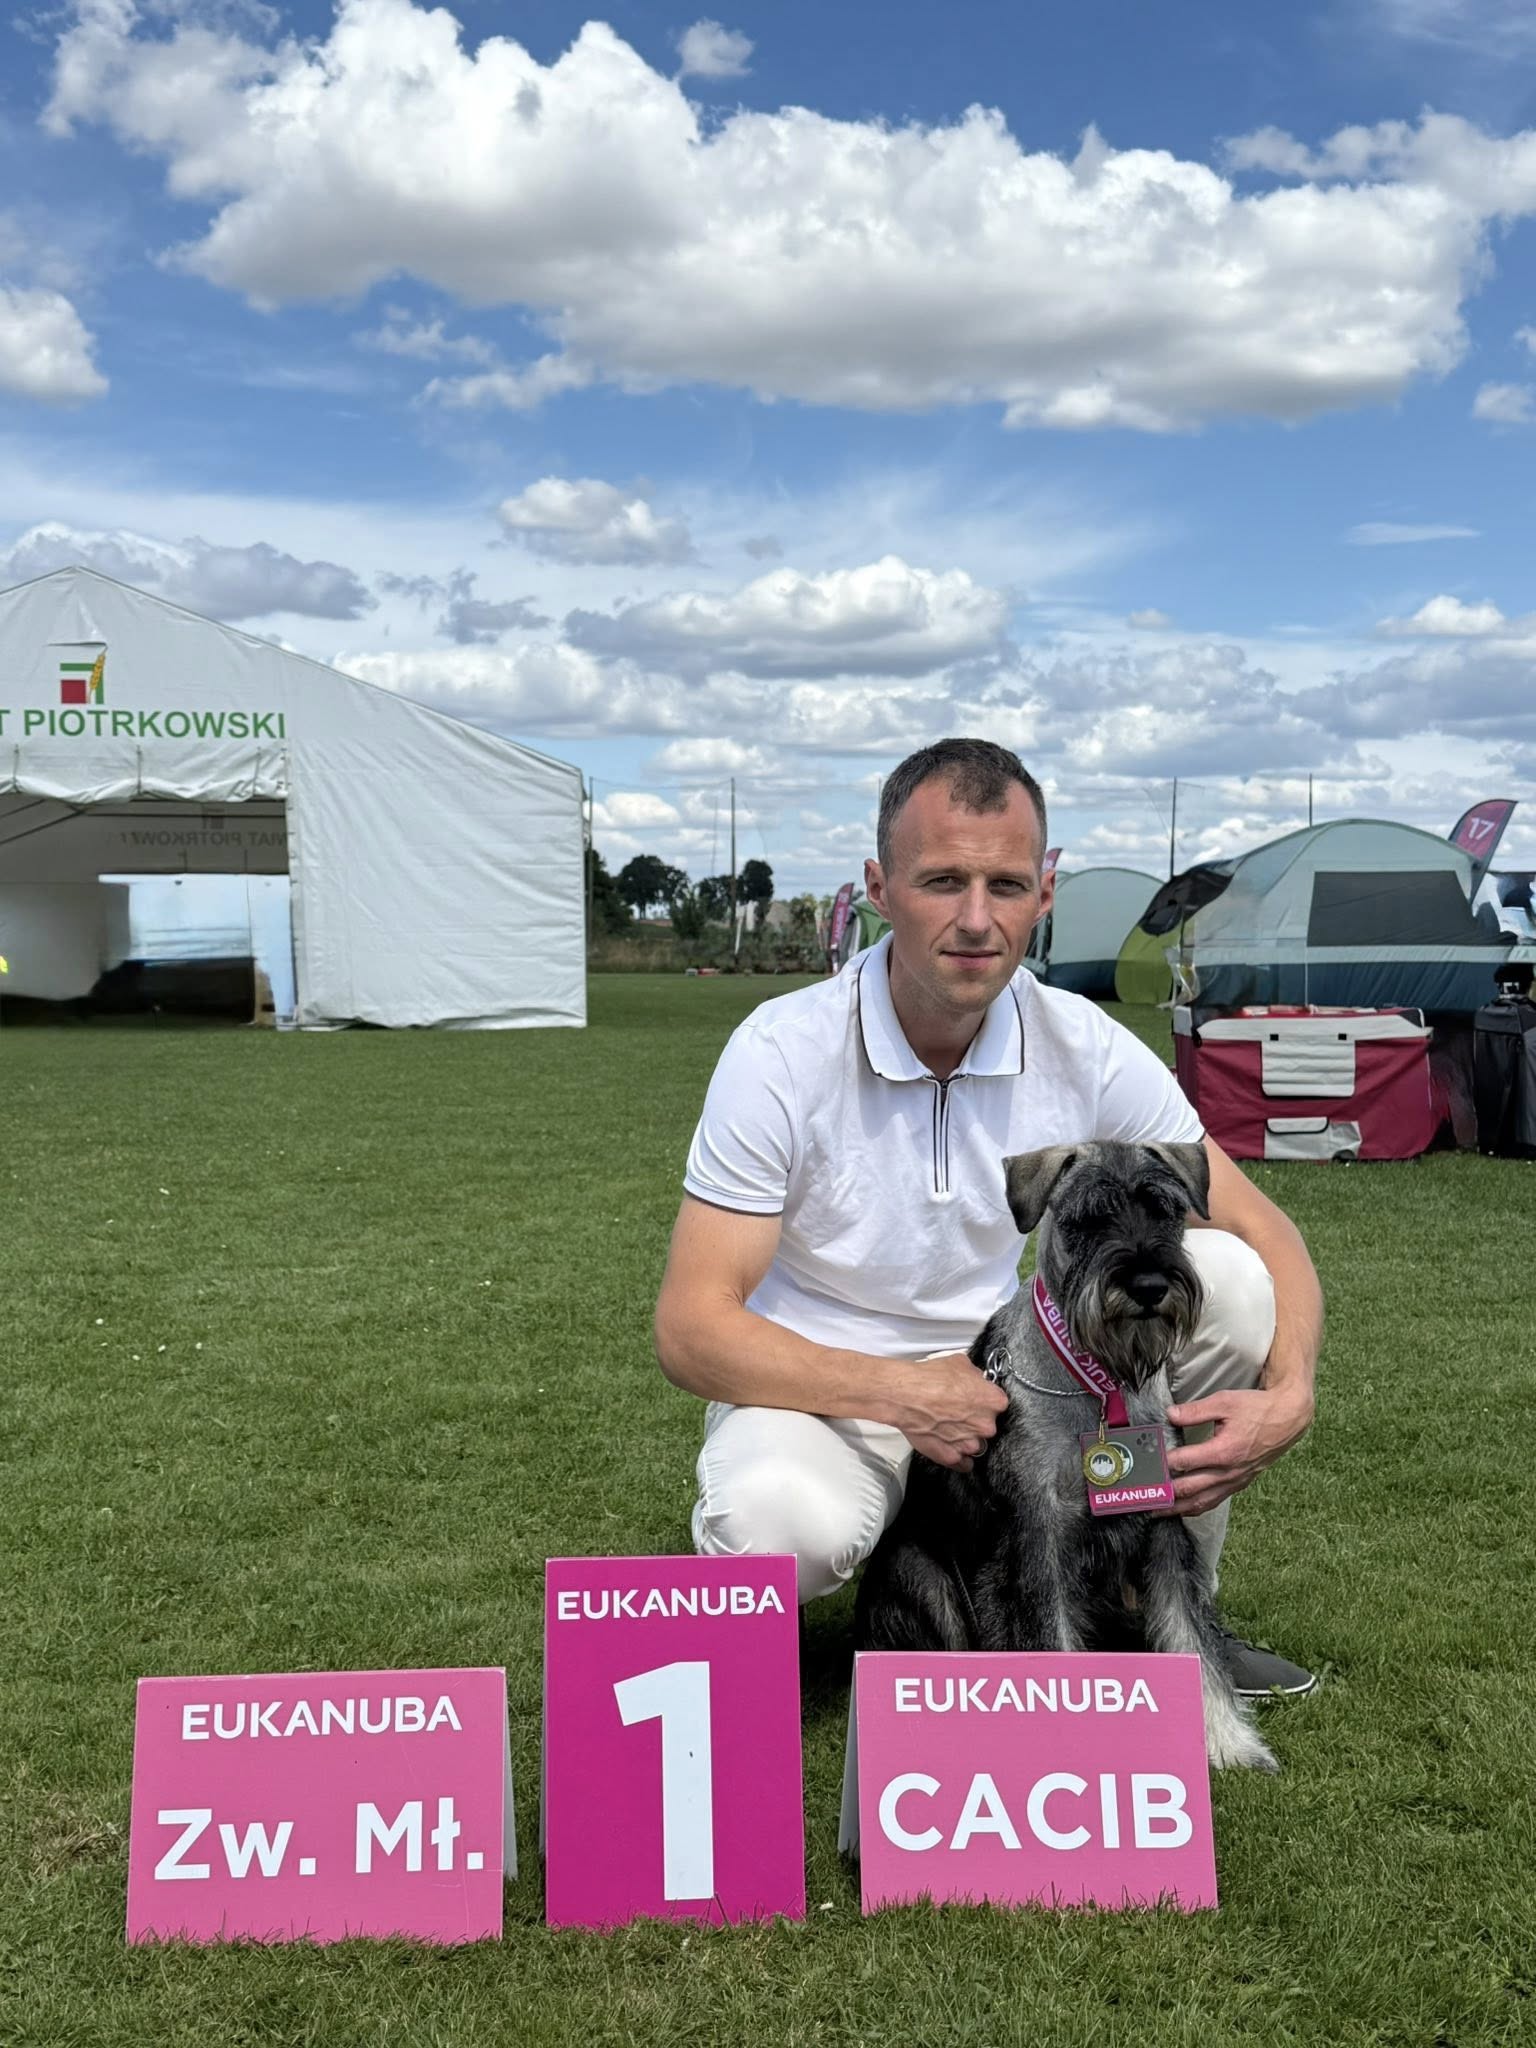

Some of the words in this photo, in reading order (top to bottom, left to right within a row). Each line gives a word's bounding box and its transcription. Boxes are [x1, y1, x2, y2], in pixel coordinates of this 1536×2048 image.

[23, 708, 286, 740] PIOTRKOWSKI
[1468, 817, 1495, 840] 17
[1095, 1487, 1166, 1504] EUKANUBA
[557, 1585, 785, 1621] EUKANUBA
[895, 1678, 1160, 1713] EUKANUBA
[182, 1695, 463, 1740] EUKANUBA
[613, 1661, 715, 1901] 1
[878, 1772, 1193, 1851] CACIB
[154, 1808, 317, 1880] Zw.
[355, 1796, 484, 1874] Mł.
